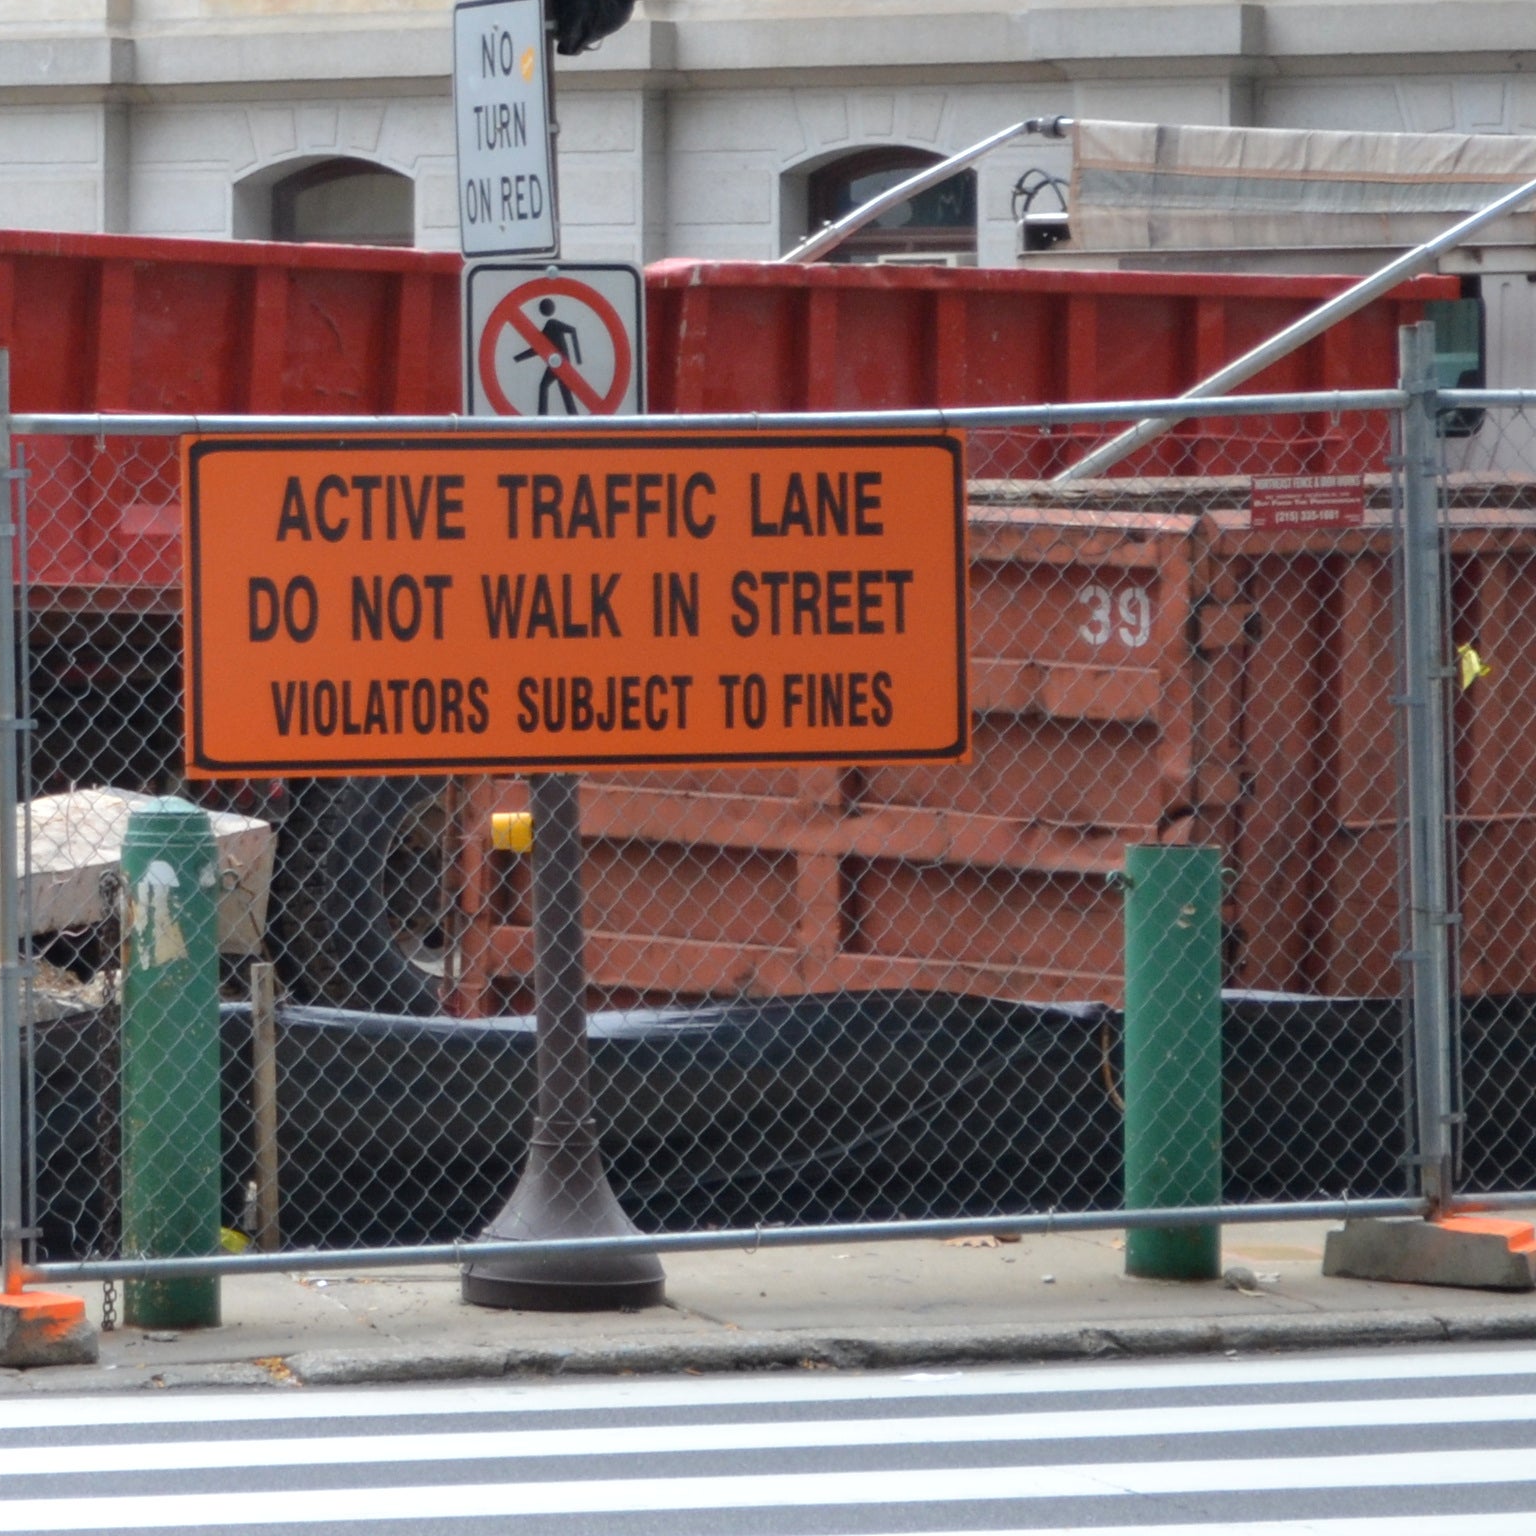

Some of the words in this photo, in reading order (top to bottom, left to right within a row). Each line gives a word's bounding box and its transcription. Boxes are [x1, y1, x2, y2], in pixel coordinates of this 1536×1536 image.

[481, 30, 514, 78] NO
[473, 102, 527, 151] TURN
[467, 178, 492, 225] ON
[501, 173, 543, 221] RED
[276, 473, 466, 543] ACTIVE
[497, 471, 717, 540] TRAFFIC
[750, 470, 884, 538] LANE
[248, 574, 319, 644] DO
[351, 573, 453, 642] NOT
[481, 572, 622, 640] WALK
[652, 571, 699, 638] IN
[731, 569, 914, 638] STREET
[1077, 584, 1151, 648] 39
[271, 676, 490, 737] VIOLATORS
[517, 674, 693, 734] SUBJECT
[718, 672, 767, 730] TO
[782, 670, 893, 728] FINES
